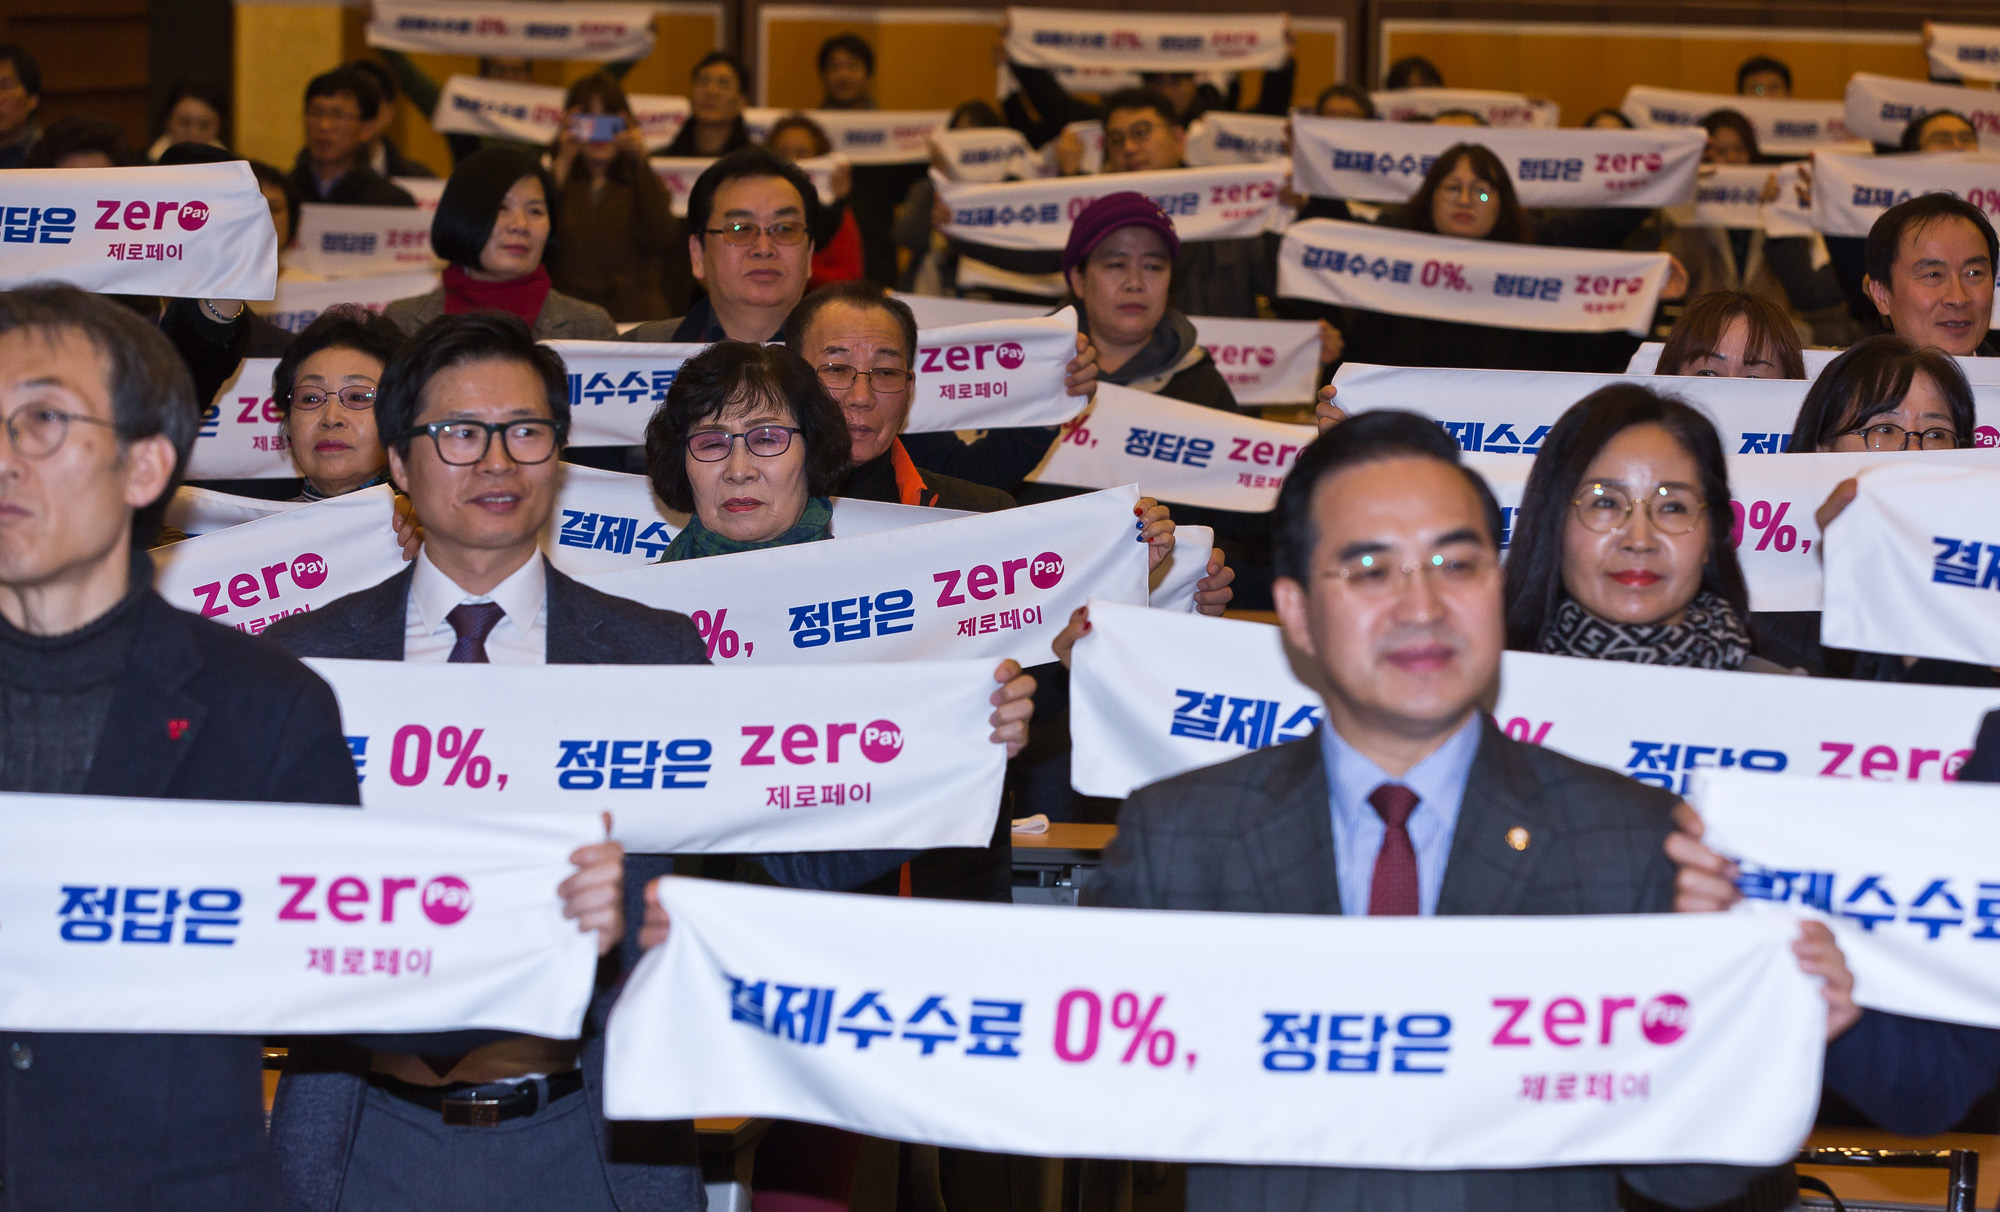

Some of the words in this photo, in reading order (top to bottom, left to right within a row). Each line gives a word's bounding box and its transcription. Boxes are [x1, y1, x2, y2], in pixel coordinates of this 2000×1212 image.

[1163, 194, 1198, 216] 답은
[0, 207, 76, 243] 답은
[107, 243, 182, 261] 제로페이
[1304, 247, 1413, 284] 결제수수료
[940, 382, 1007, 400] 제로페이
[1124, 427, 1214, 468] 정답은
[295, 559, 328, 578] Pay
[789, 589, 914, 648] 정답은
[1034, 560, 1064, 575] Pay
[956, 604, 1043, 637] 제로페이
[390, 725, 508, 790] 0%,
[557, 739, 712, 790] 정답은
[865, 728, 904, 749] Pay
[766, 783, 870, 809] 제로페이
[59, 886, 242, 945] 정답은
[309, 949, 430, 975] 제로페이
[1054, 989, 1196, 1067] 0%,
[1261, 1013, 1451, 1073] 정답은
[1521, 1072, 1650, 1103] 제로페이
